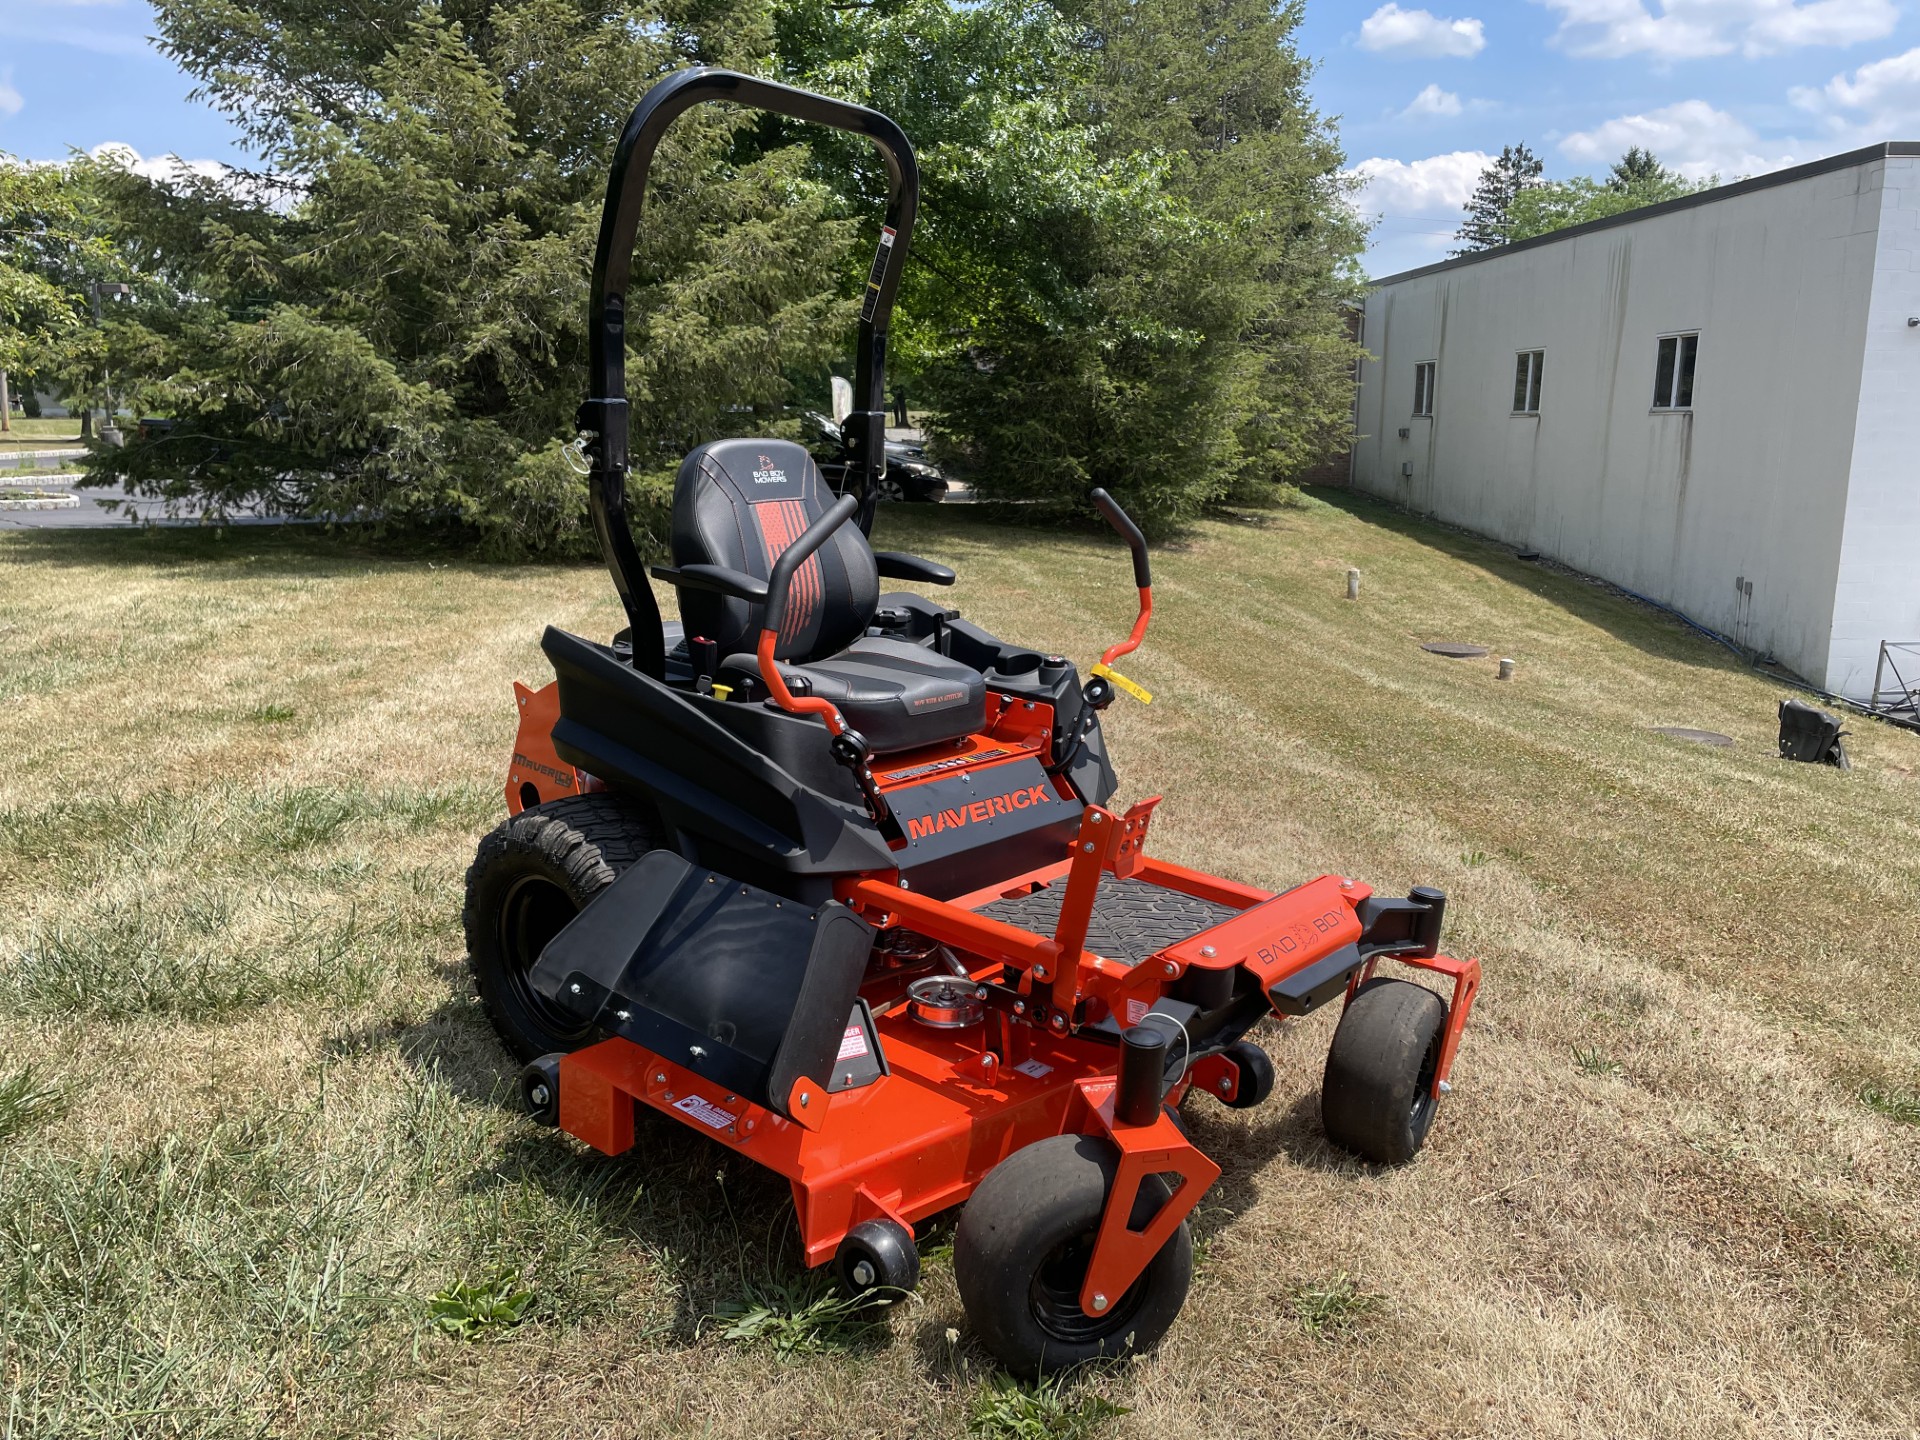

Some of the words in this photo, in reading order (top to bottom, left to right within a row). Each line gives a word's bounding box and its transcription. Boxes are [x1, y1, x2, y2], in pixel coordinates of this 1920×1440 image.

[944, 692, 963, 701] ATTITUDE
[512, 753, 574, 784] MAVERICK
[907, 784, 1050, 840] MAVERICK
[1257, 936, 1297, 965] BAD
[1313, 906, 1347, 932] BOY
[713, 1107, 737, 1121] DANGER
